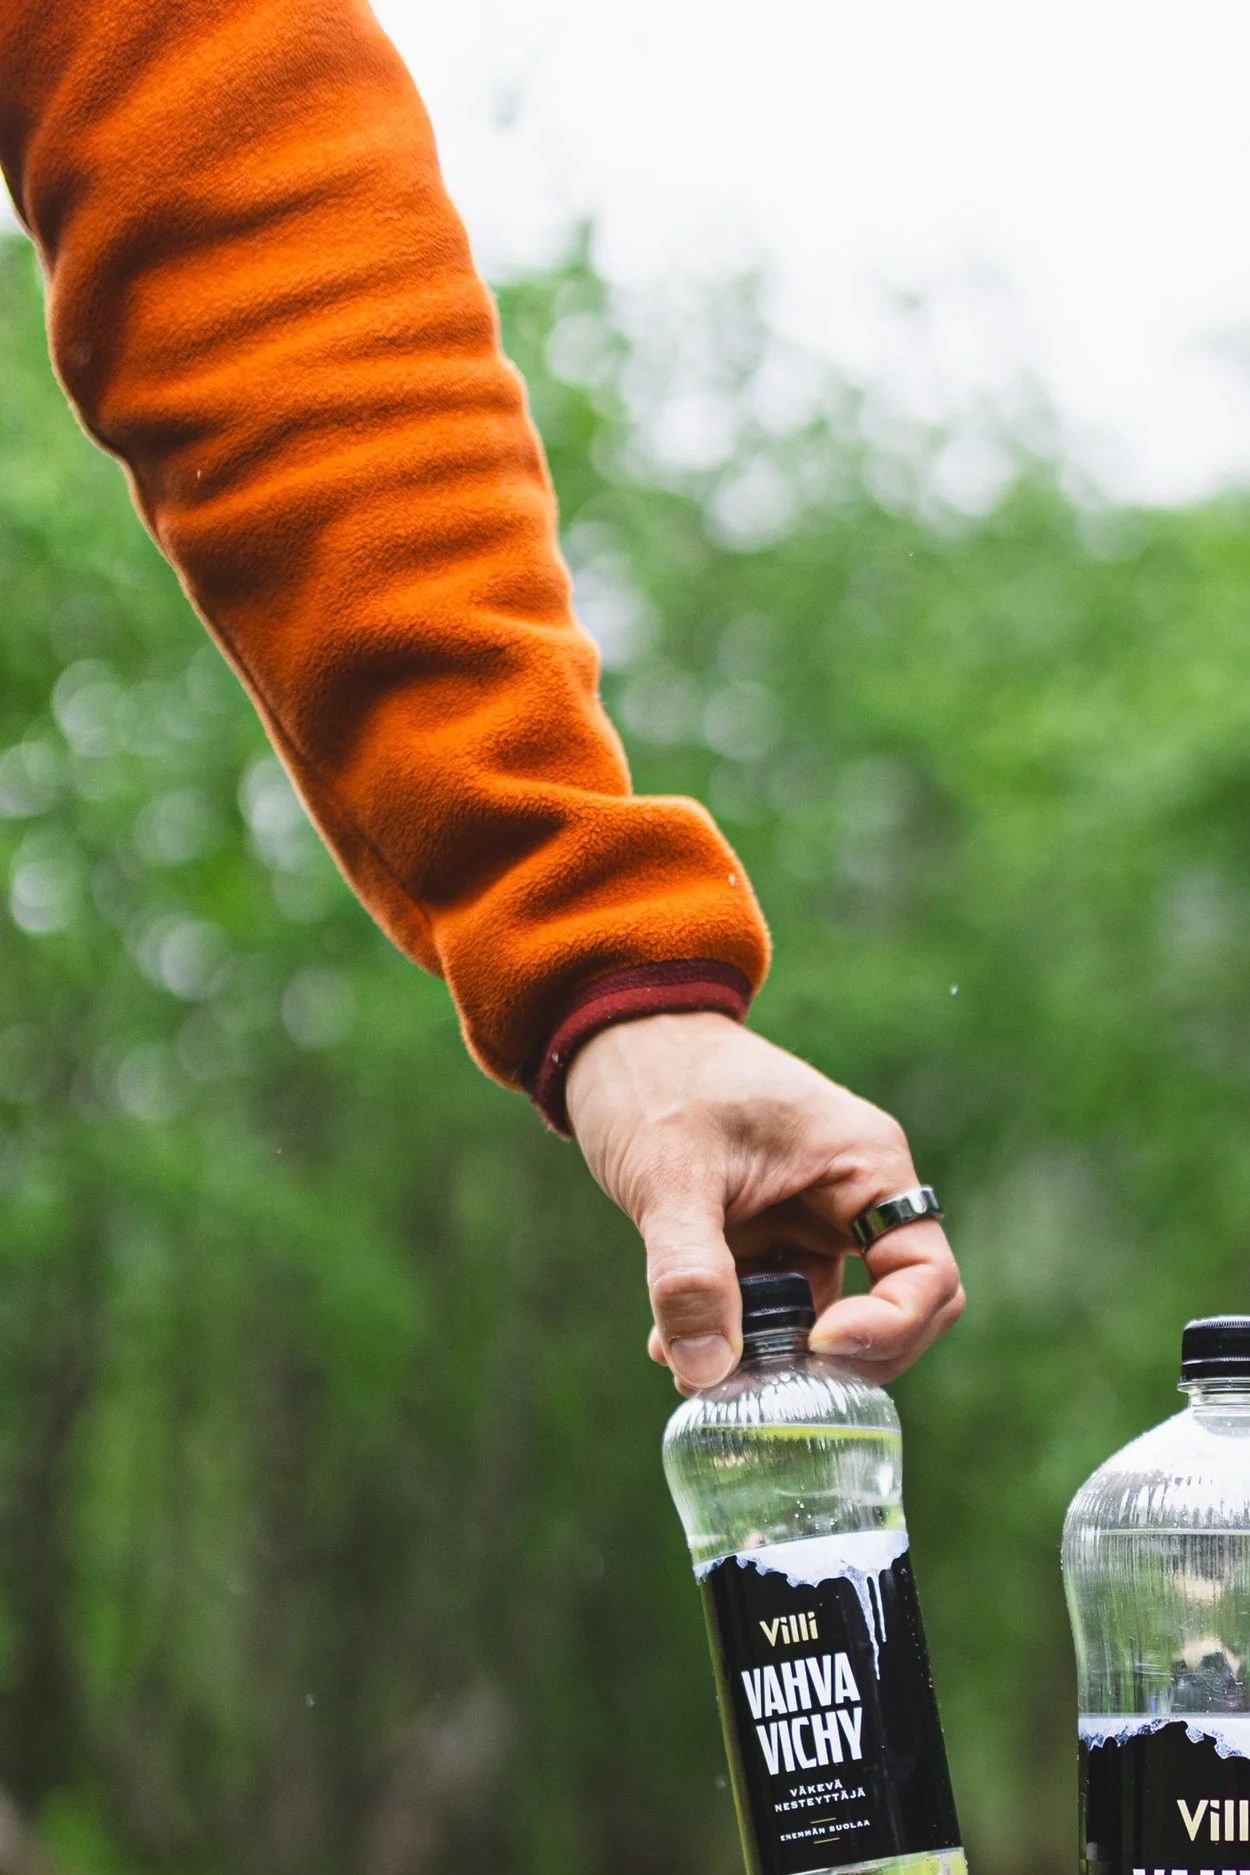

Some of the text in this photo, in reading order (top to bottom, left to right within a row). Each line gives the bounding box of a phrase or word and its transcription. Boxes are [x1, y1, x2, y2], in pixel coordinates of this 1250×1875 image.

[759, 1611, 819, 1647] Villi
[741, 1652, 861, 1719] VAHVA
[755, 1707, 863, 1775] VICHY
[774, 1787, 866, 1812] NESTEYTTÄJÄ
[789, 1779, 843, 1798] VÄKEVÄ
[780, 1819, 871, 1842] ENEMMÄN SUOLAA
